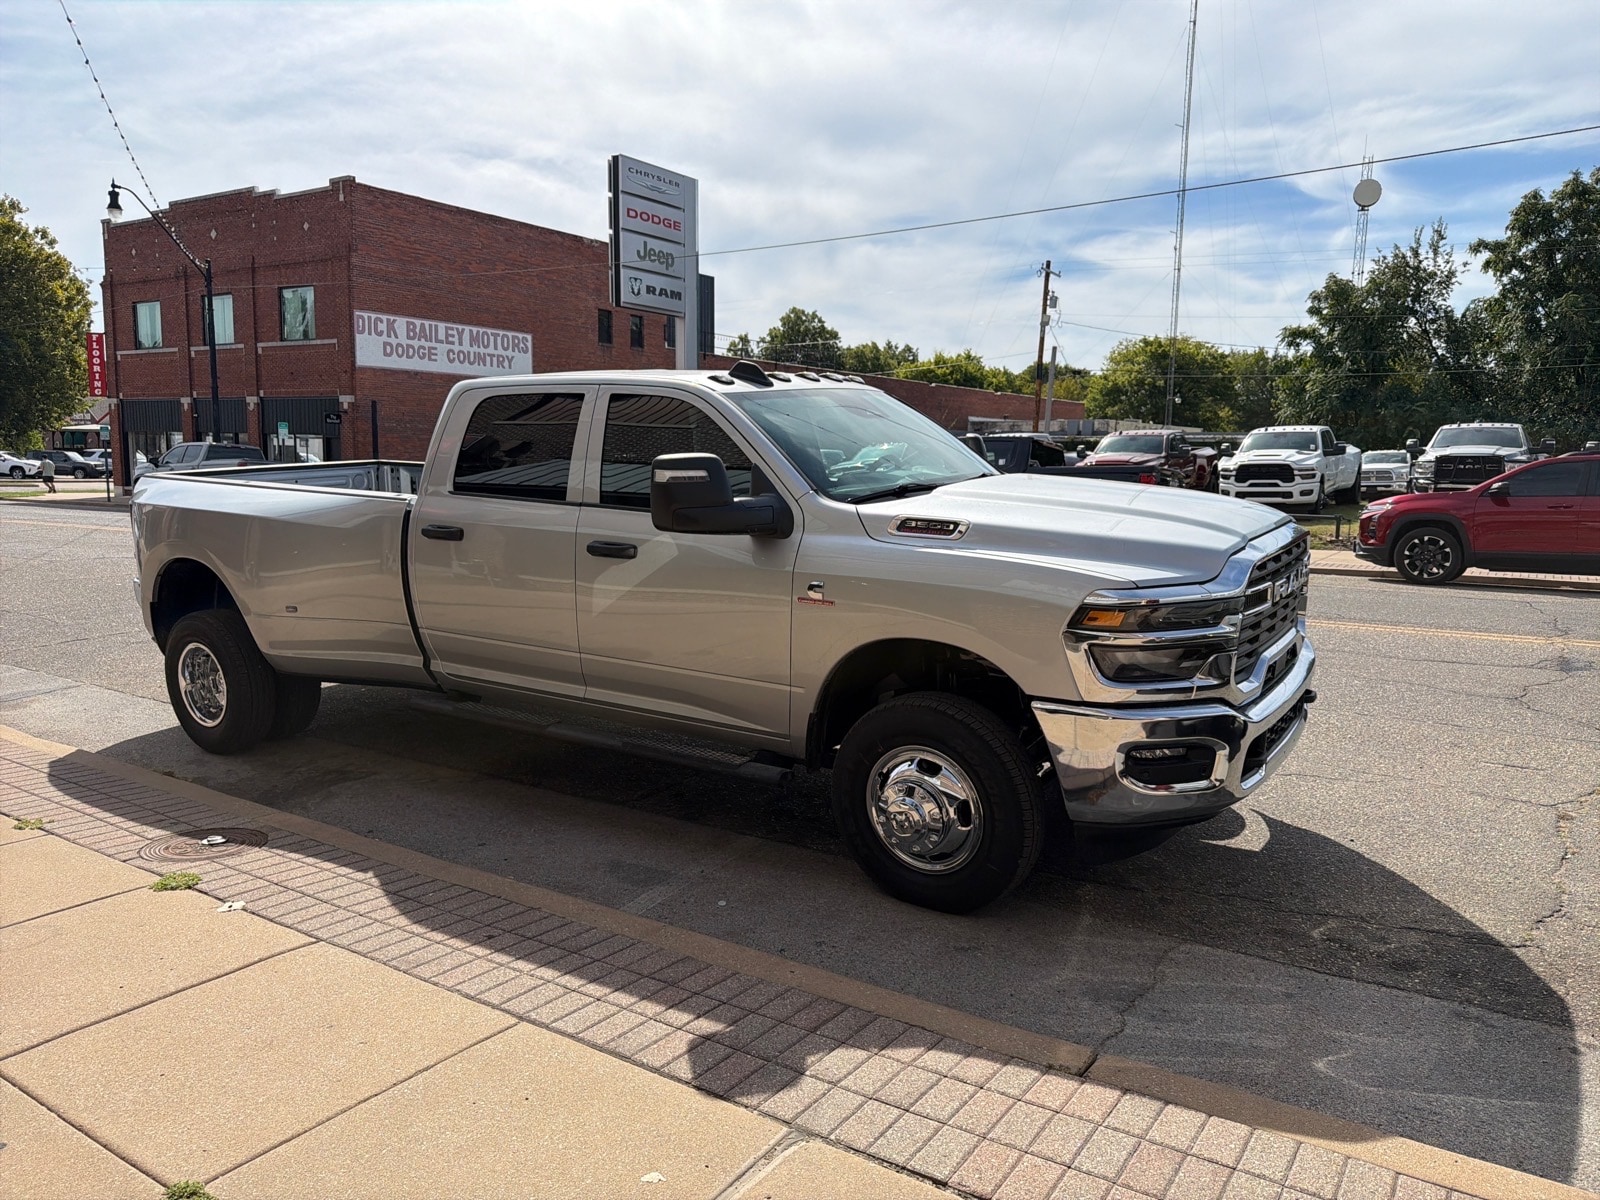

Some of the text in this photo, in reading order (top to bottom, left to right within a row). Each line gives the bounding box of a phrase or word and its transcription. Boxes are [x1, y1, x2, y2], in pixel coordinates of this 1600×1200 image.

[628, 166, 681, 189] CHRYSLER
[626, 207, 682, 232] DODGE
[636, 240, 675, 271] Jeep
[645, 284, 682, 301] RAM
[356, 314, 530, 354] DICK BAILEY MOTORS
[91, 334, 102, 396] FLOORING
[382, 341, 515, 370] DODGE COUNTRY
[904, 520, 955, 530] 3500
